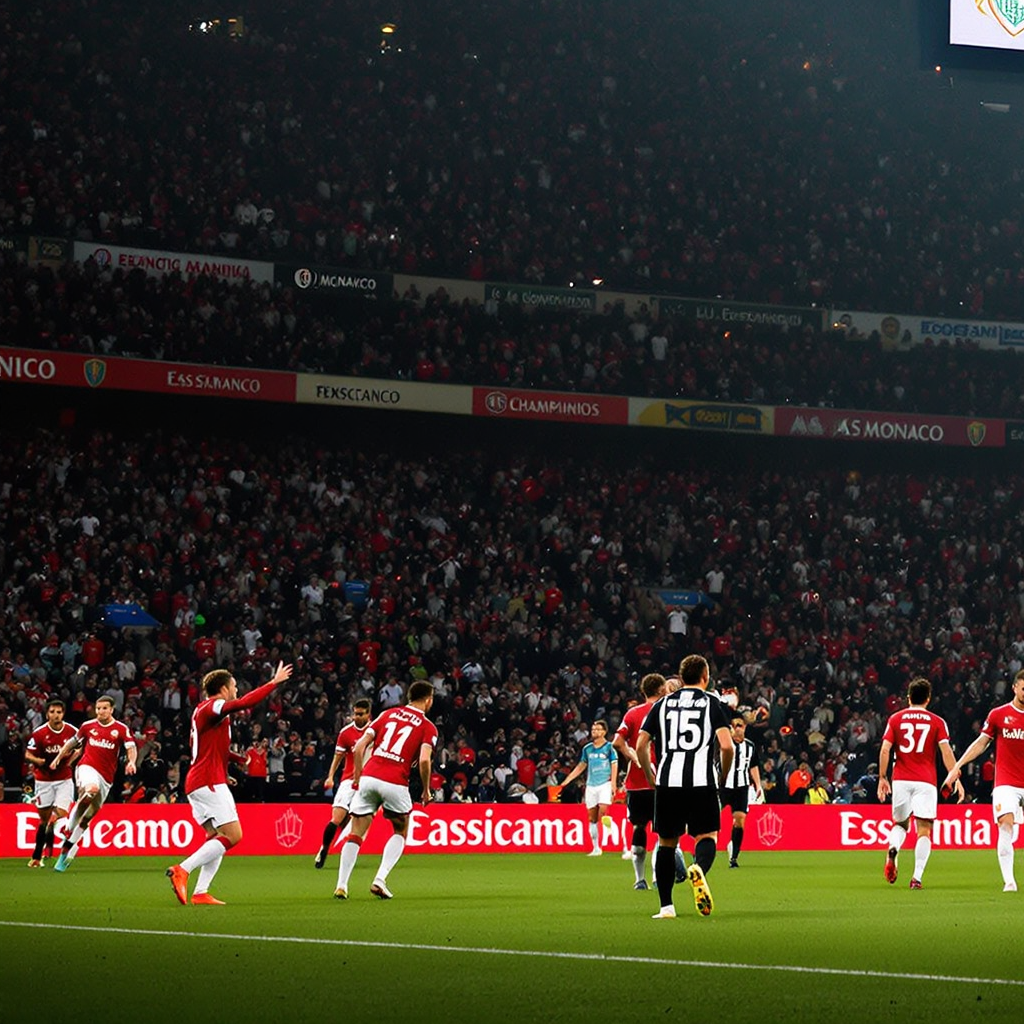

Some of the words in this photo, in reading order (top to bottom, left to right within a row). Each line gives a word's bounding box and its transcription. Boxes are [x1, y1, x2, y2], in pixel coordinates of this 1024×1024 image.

[864, 422, 944, 442] MONACO
[380, 721, 413, 755] 11
[666, 710, 702, 750] 15
[900, 722, 931, 753] 37
